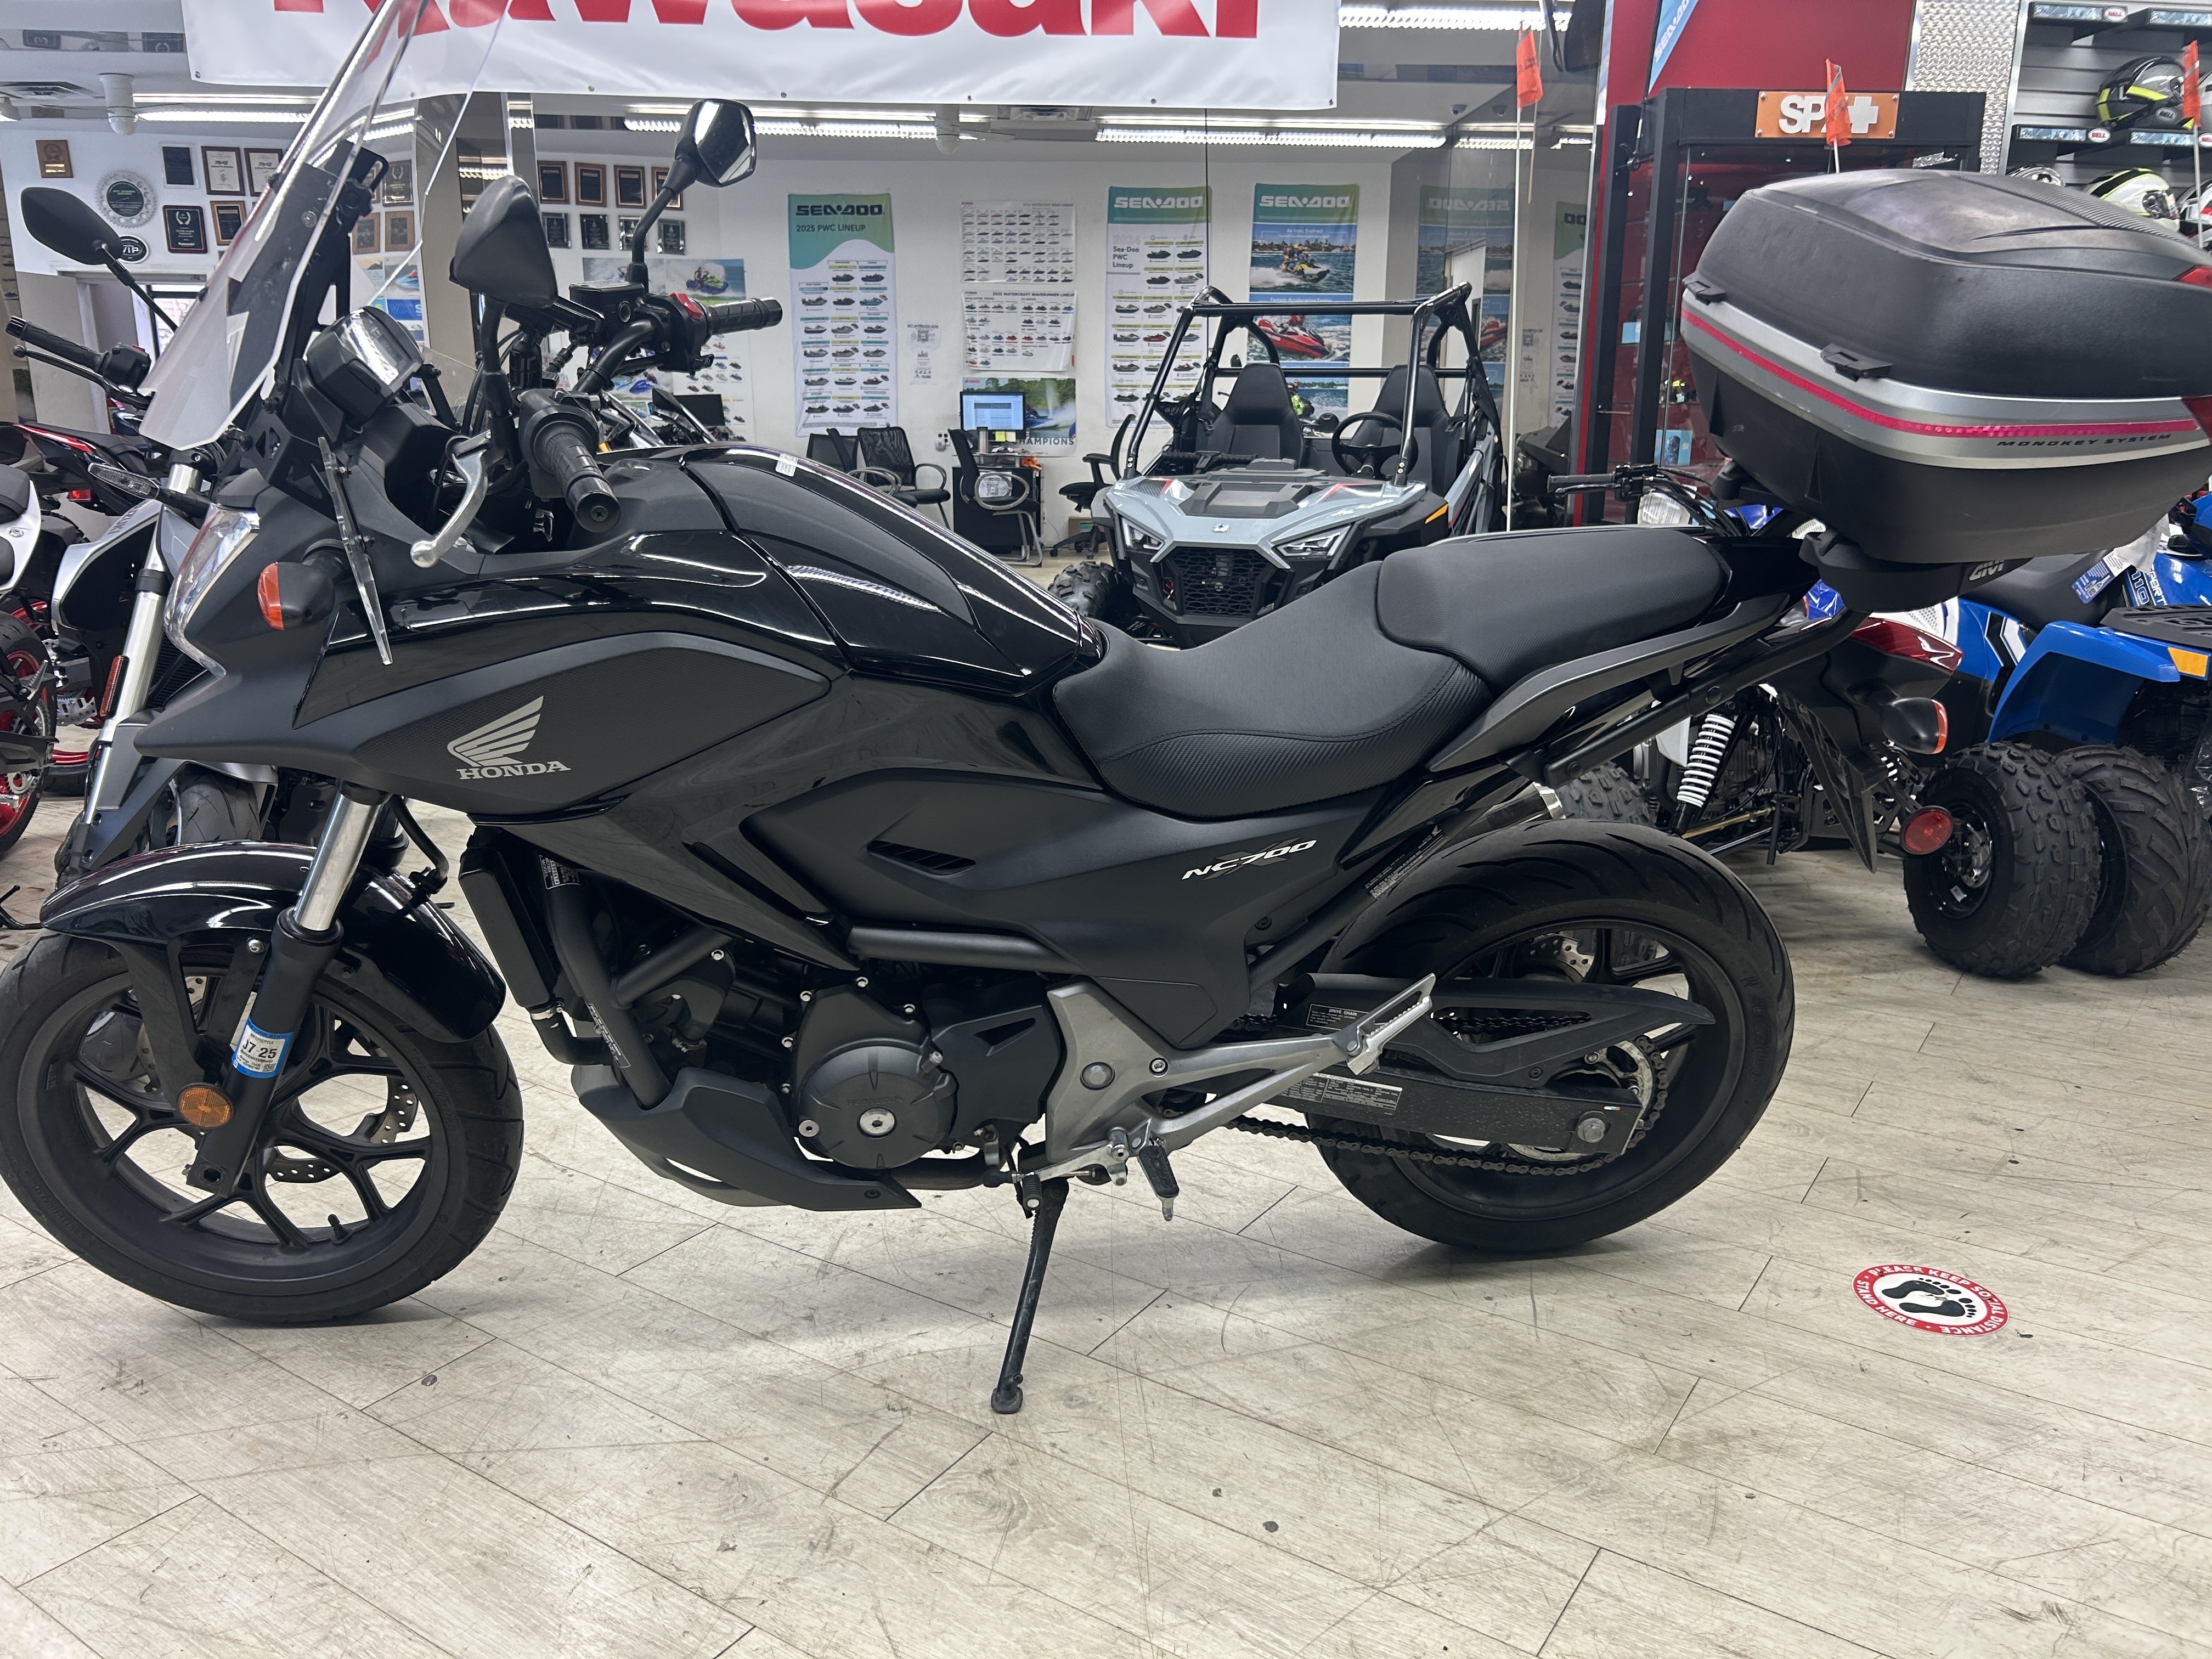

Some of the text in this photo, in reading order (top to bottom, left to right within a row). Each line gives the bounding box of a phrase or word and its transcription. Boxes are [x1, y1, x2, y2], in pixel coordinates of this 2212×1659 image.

[1779, 95, 1849, 133] SP
[2103, 434, 2171, 445] SYSTEM
[1968, 560, 2005, 581] GIVI
[2131, 570, 2149, 605] 110
[456, 760, 572, 780] HONDA
[1928, 1268, 1971, 1287] KEEP
[1857, 1279, 1917, 1326] STAND HERE
[1940, 1315, 2004, 1335] DISTANCE
